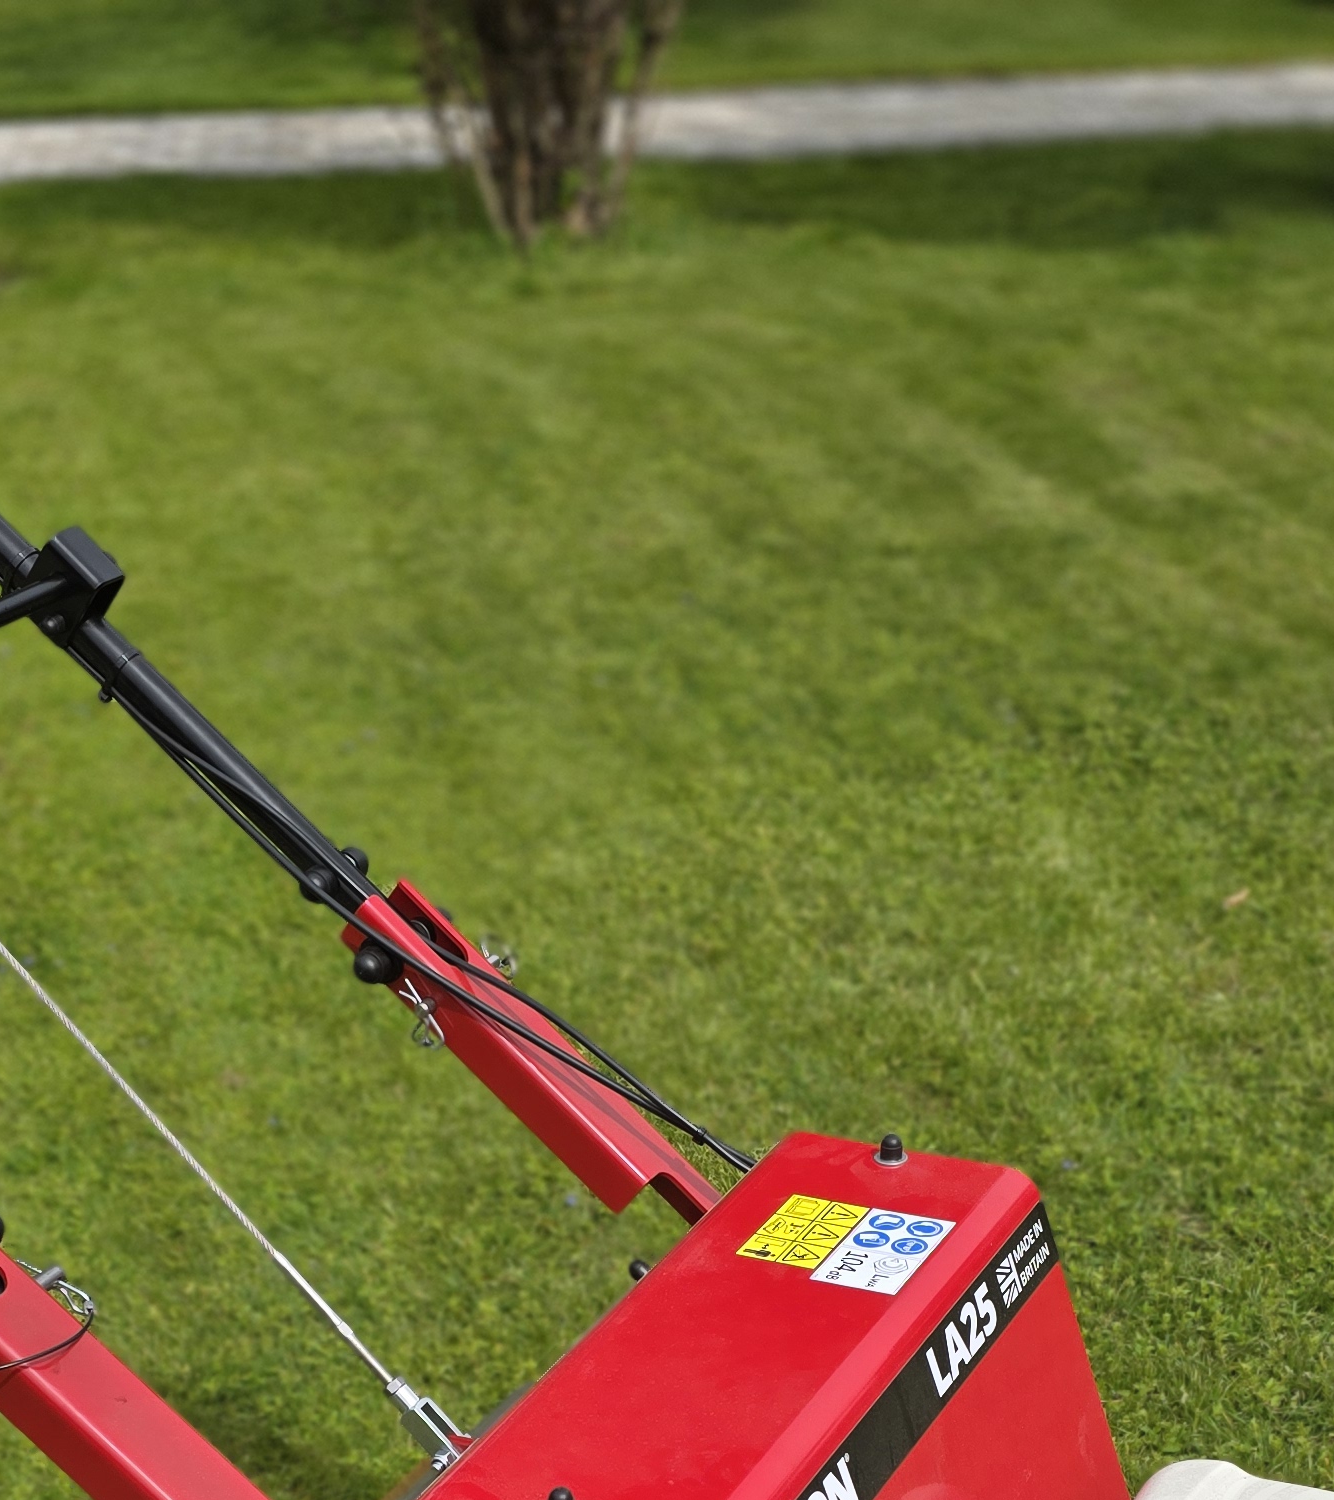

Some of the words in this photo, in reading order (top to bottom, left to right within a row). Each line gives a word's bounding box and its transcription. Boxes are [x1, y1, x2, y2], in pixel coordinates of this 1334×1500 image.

[840, 1250, 869, 1273] 104
[1013, 1230, 1034, 1262] MADE
[1033, 1218, 1044, 1238] IN
[1020, 1242, 1050, 1287] BRITAIN
[925, 1281, 998, 1398] LA25
